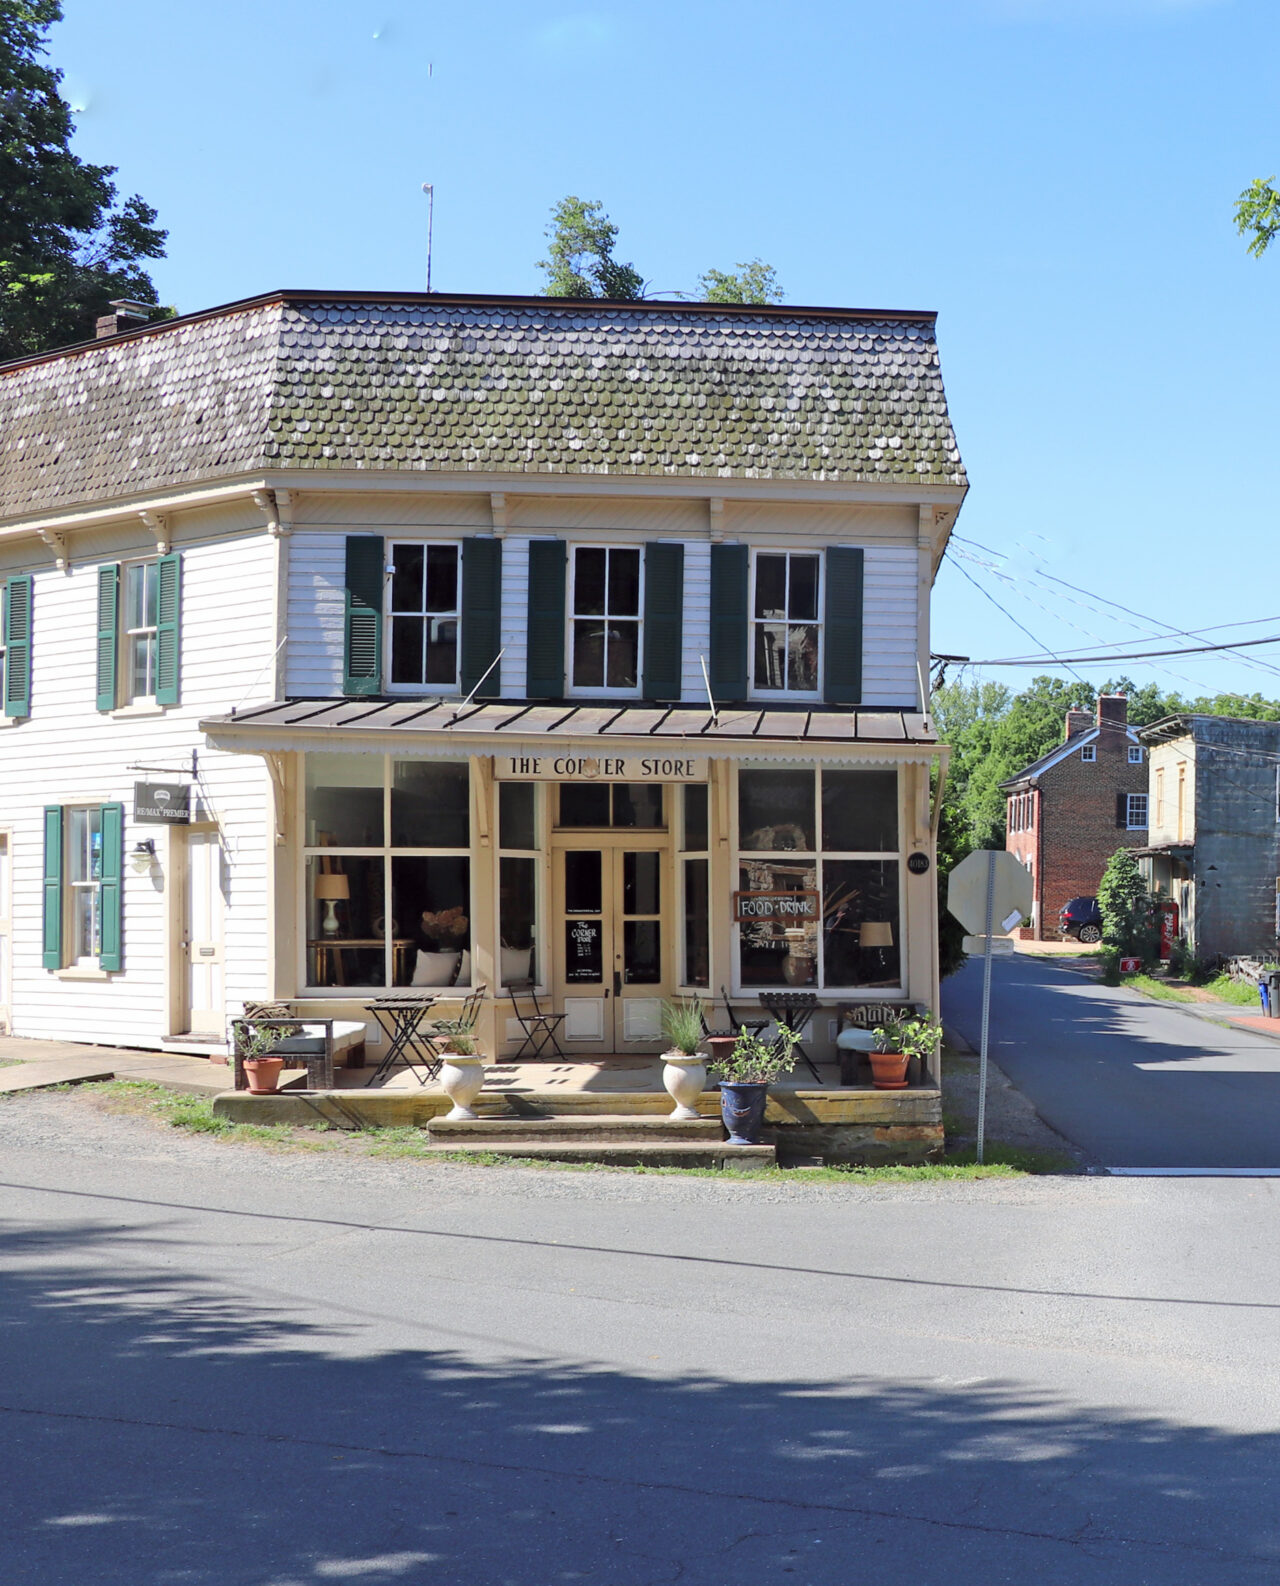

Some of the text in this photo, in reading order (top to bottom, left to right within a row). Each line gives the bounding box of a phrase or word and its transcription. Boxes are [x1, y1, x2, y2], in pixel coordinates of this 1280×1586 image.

[510, 757, 695, 776] THE COER STORE
[163, 808, 189, 817] PREMIER
[741, 900, 813, 915] FOOD DRINK
[571, 928, 597, 938] CORNER
